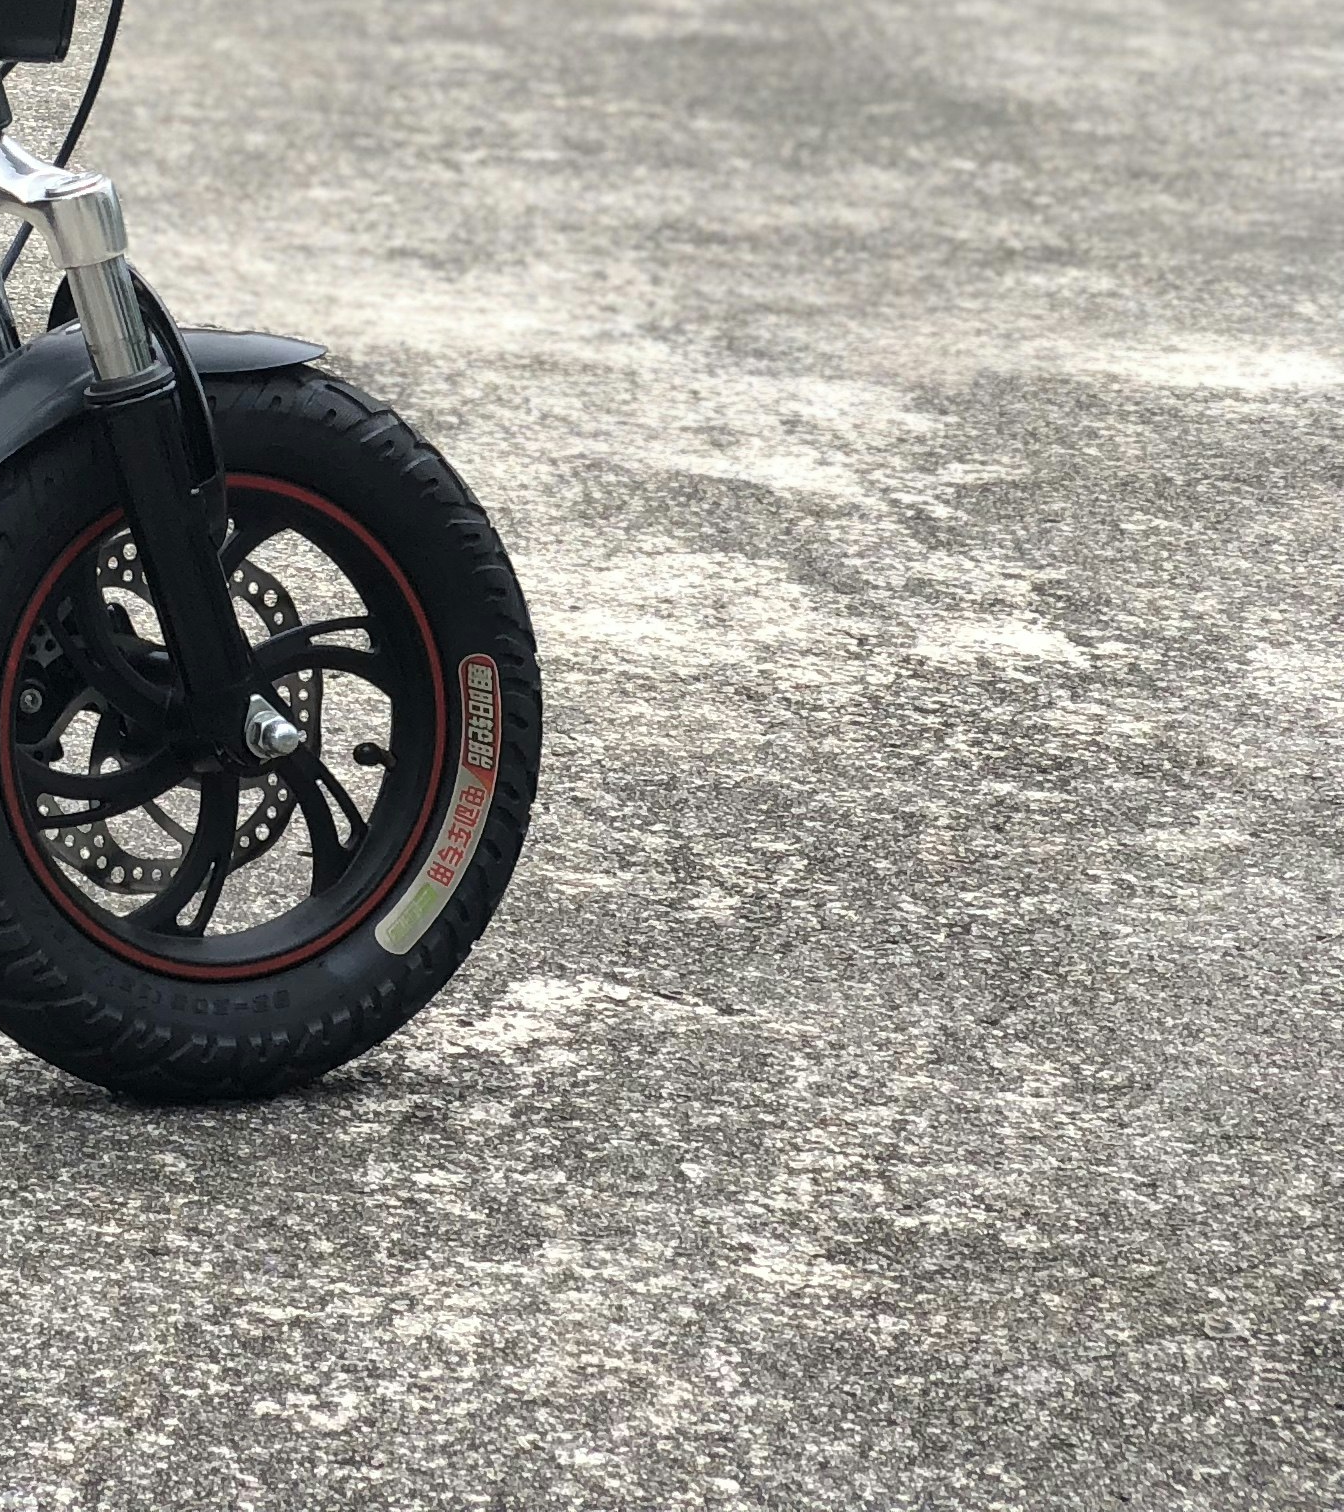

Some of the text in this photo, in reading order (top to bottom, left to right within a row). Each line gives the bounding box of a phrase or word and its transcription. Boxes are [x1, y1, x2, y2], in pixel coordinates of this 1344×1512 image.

[426, 785, 486, 888] 电动车专用
